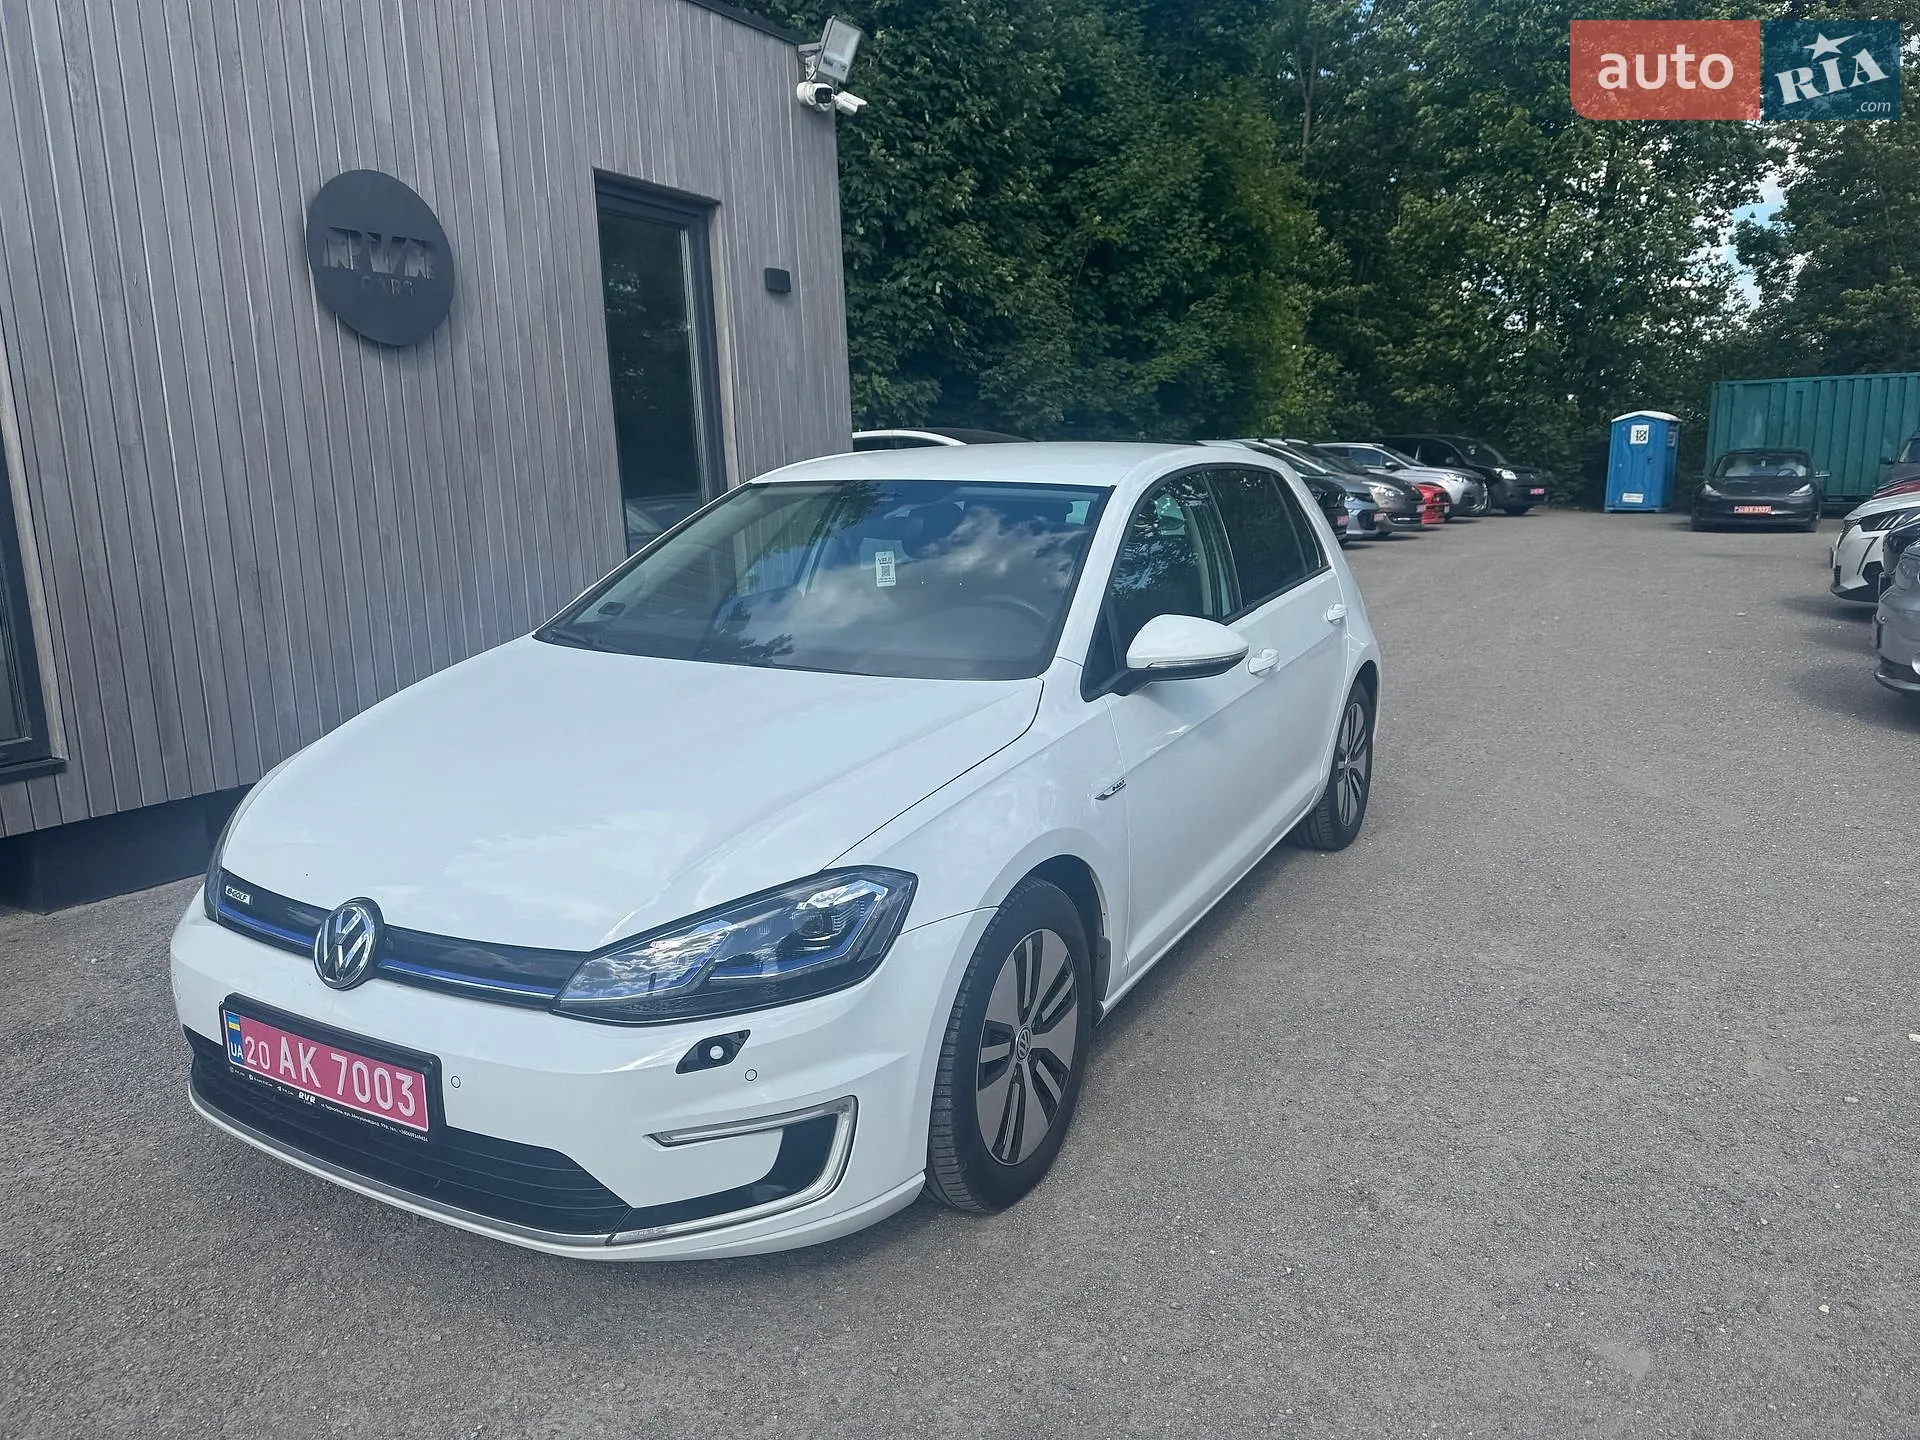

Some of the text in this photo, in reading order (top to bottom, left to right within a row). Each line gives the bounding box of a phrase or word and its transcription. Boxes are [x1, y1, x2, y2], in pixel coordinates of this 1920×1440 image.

[230, 1042, 244, 1060] UA
[244, 1035, 417, 1117] 20 AK 7003
[298, 1091, 316, 1104] RVR
